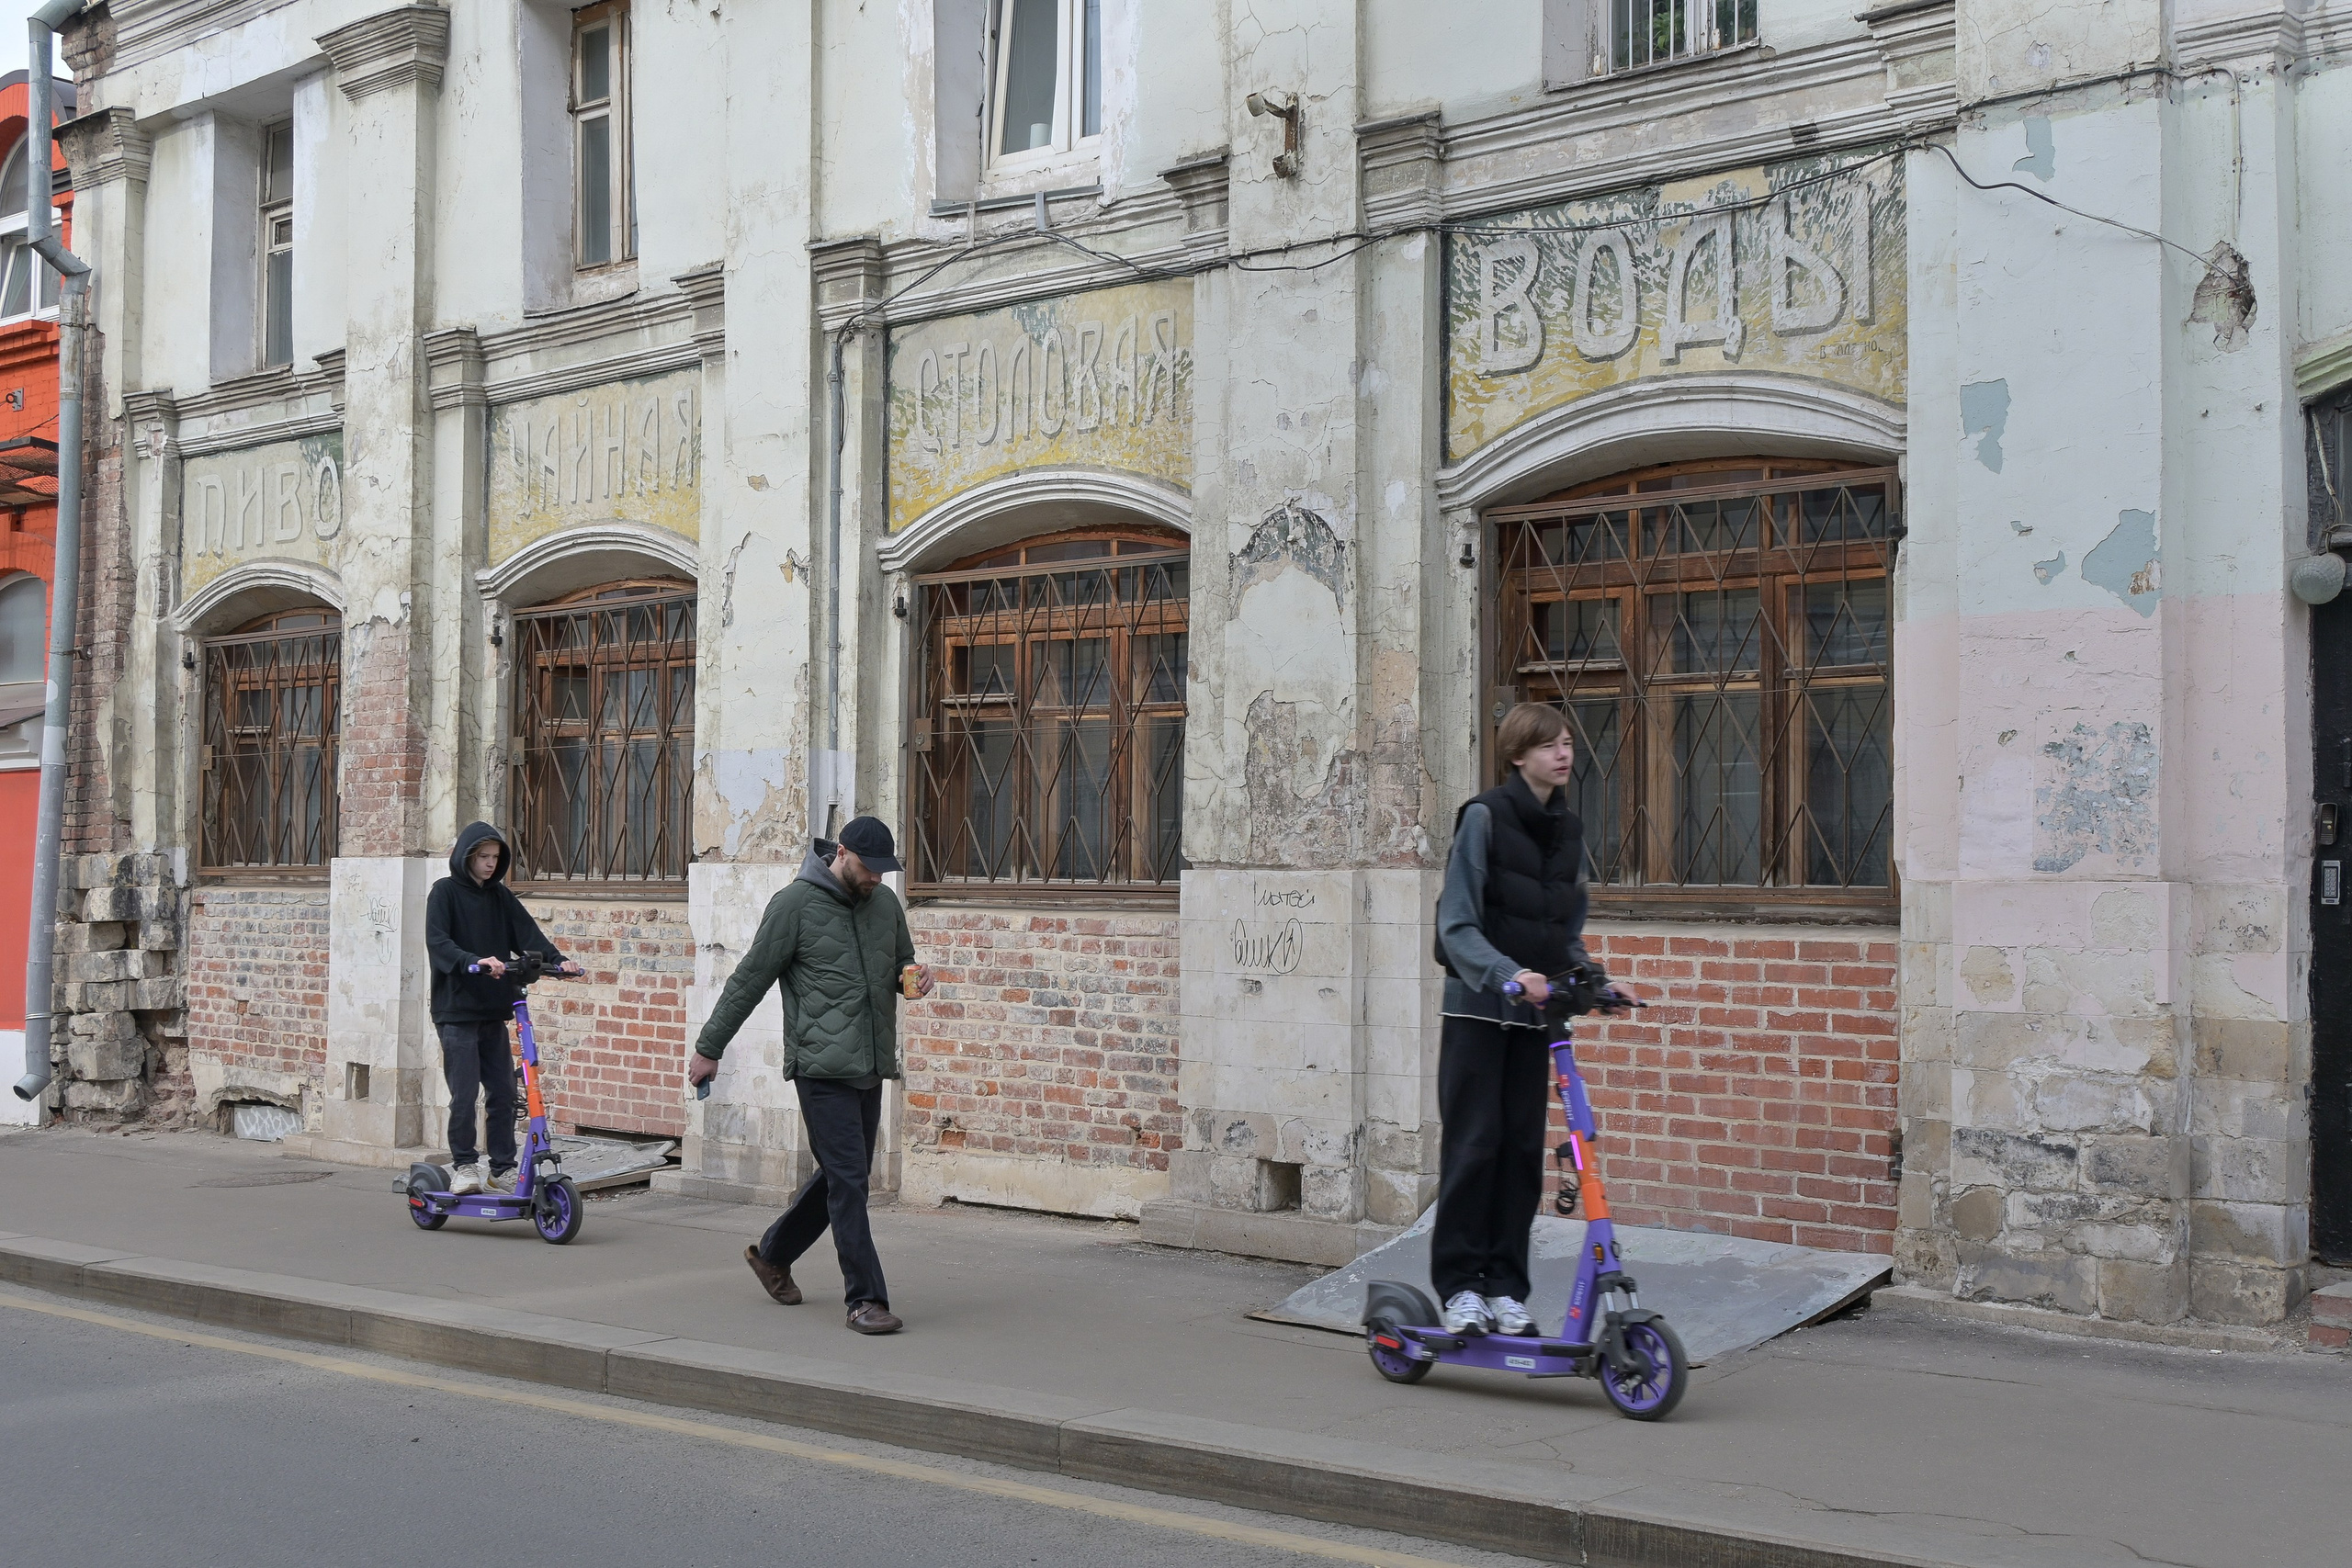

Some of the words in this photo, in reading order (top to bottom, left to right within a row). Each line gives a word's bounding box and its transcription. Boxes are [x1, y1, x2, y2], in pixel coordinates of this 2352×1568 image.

[1473, 184, 1875, 379] ВОДЫ
[915, 309, 1178, 457] СТОЛОВАЯ
[197, 457, 344, 558] ПИВО
[506, 389, 695, 525] ЧАЙНАЯ
